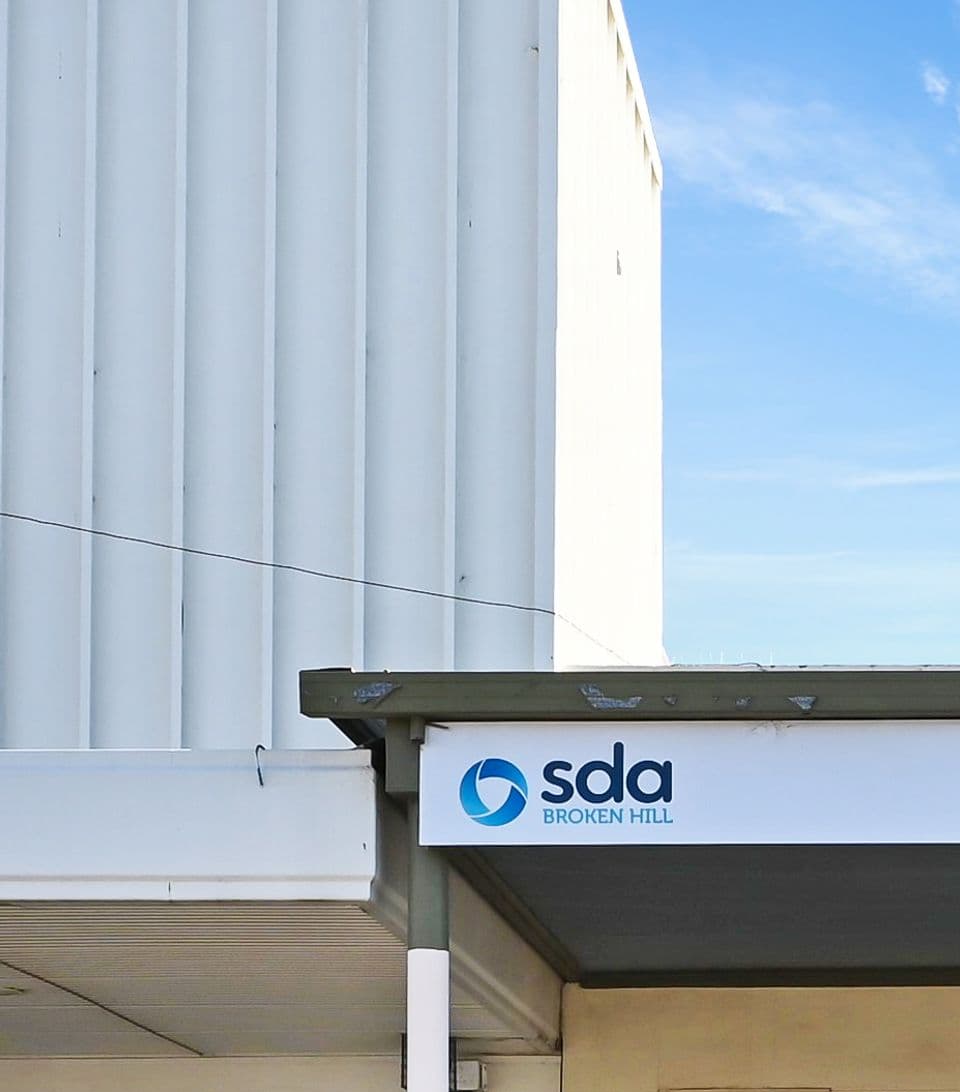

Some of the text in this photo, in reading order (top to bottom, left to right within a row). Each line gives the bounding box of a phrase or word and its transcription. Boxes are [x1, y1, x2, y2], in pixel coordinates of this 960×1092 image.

[541, 741, 673, 804] sda
[543, 808, 673, 824] BROKEN HILL
